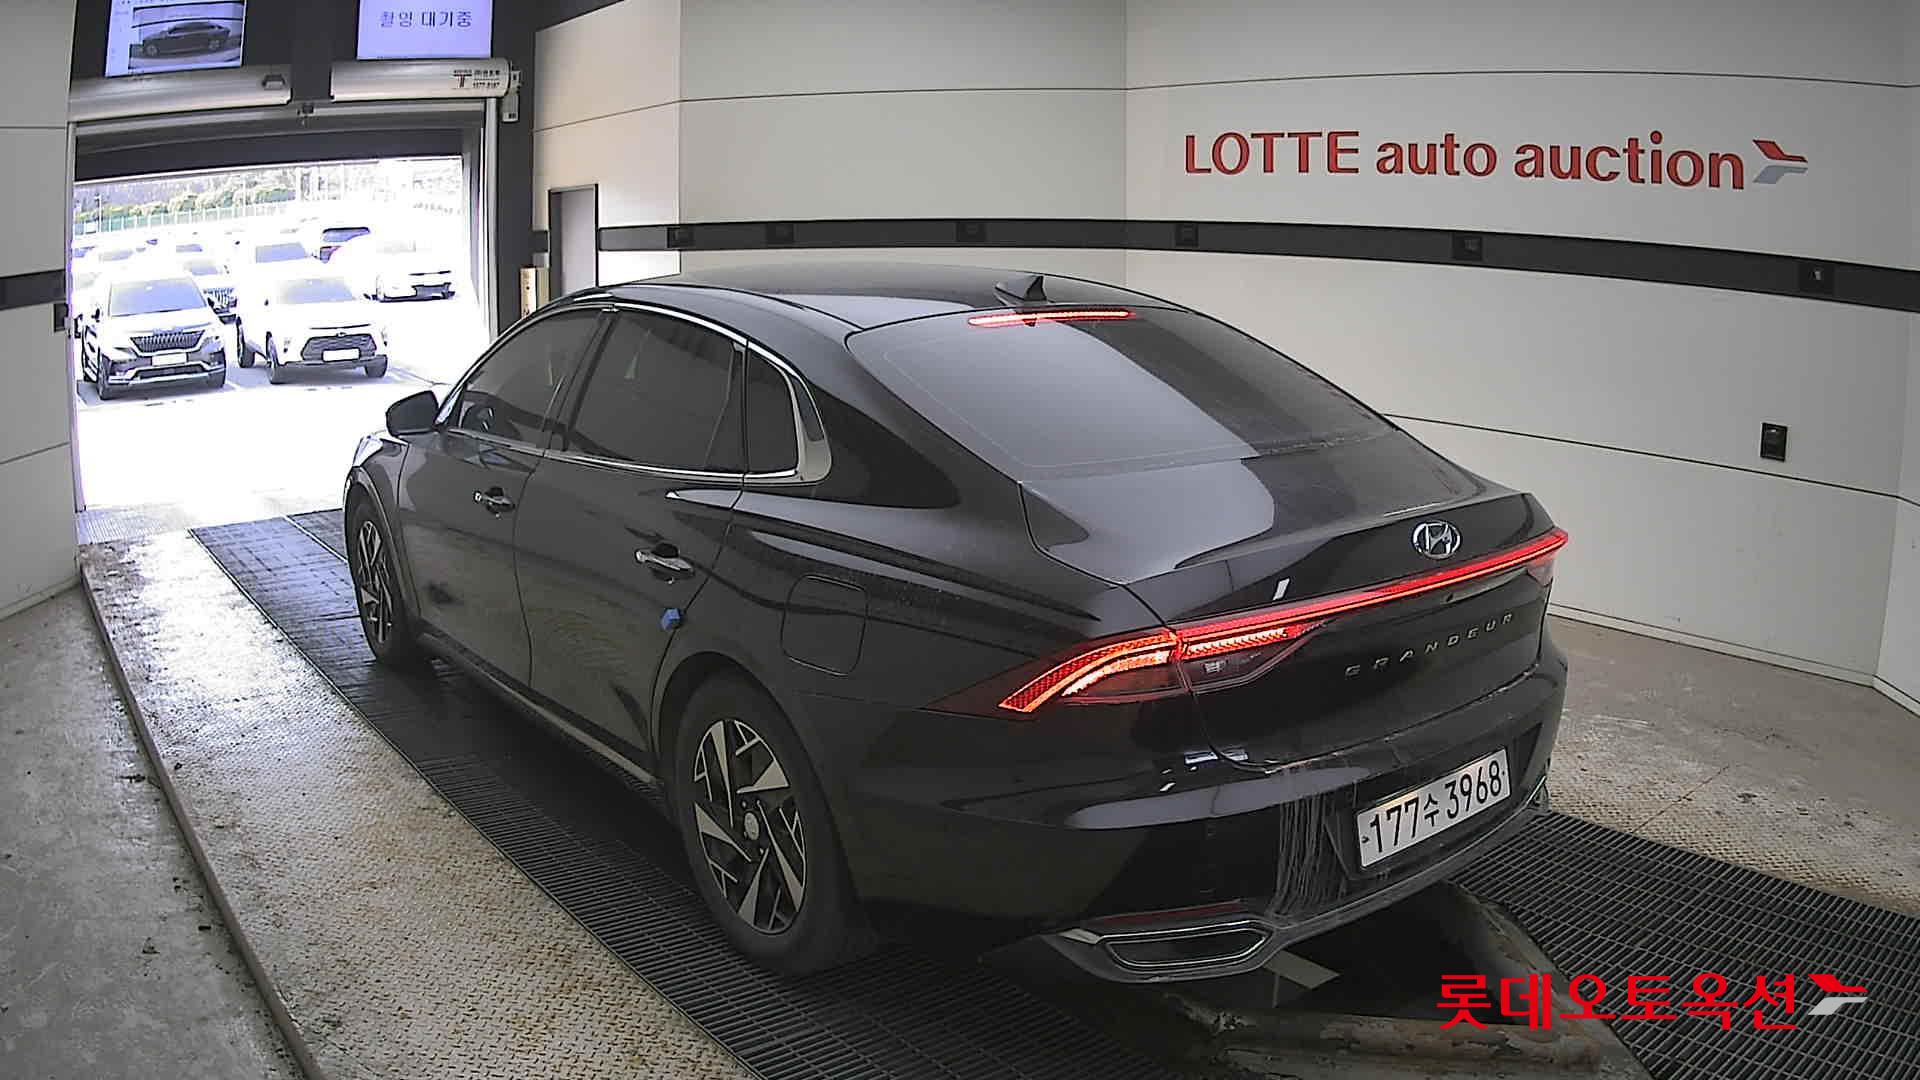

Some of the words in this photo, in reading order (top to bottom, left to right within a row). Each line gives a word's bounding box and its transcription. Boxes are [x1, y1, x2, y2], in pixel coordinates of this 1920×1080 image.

[421, 11, 473, 27] 대기중
[1184, 131, 1360, 176] LOTTE
[1375, 132, 1497, 177] auto
[1514, 130, 1744, 190] auction
[1345, 613, 1513, 677] GRANDEUR
